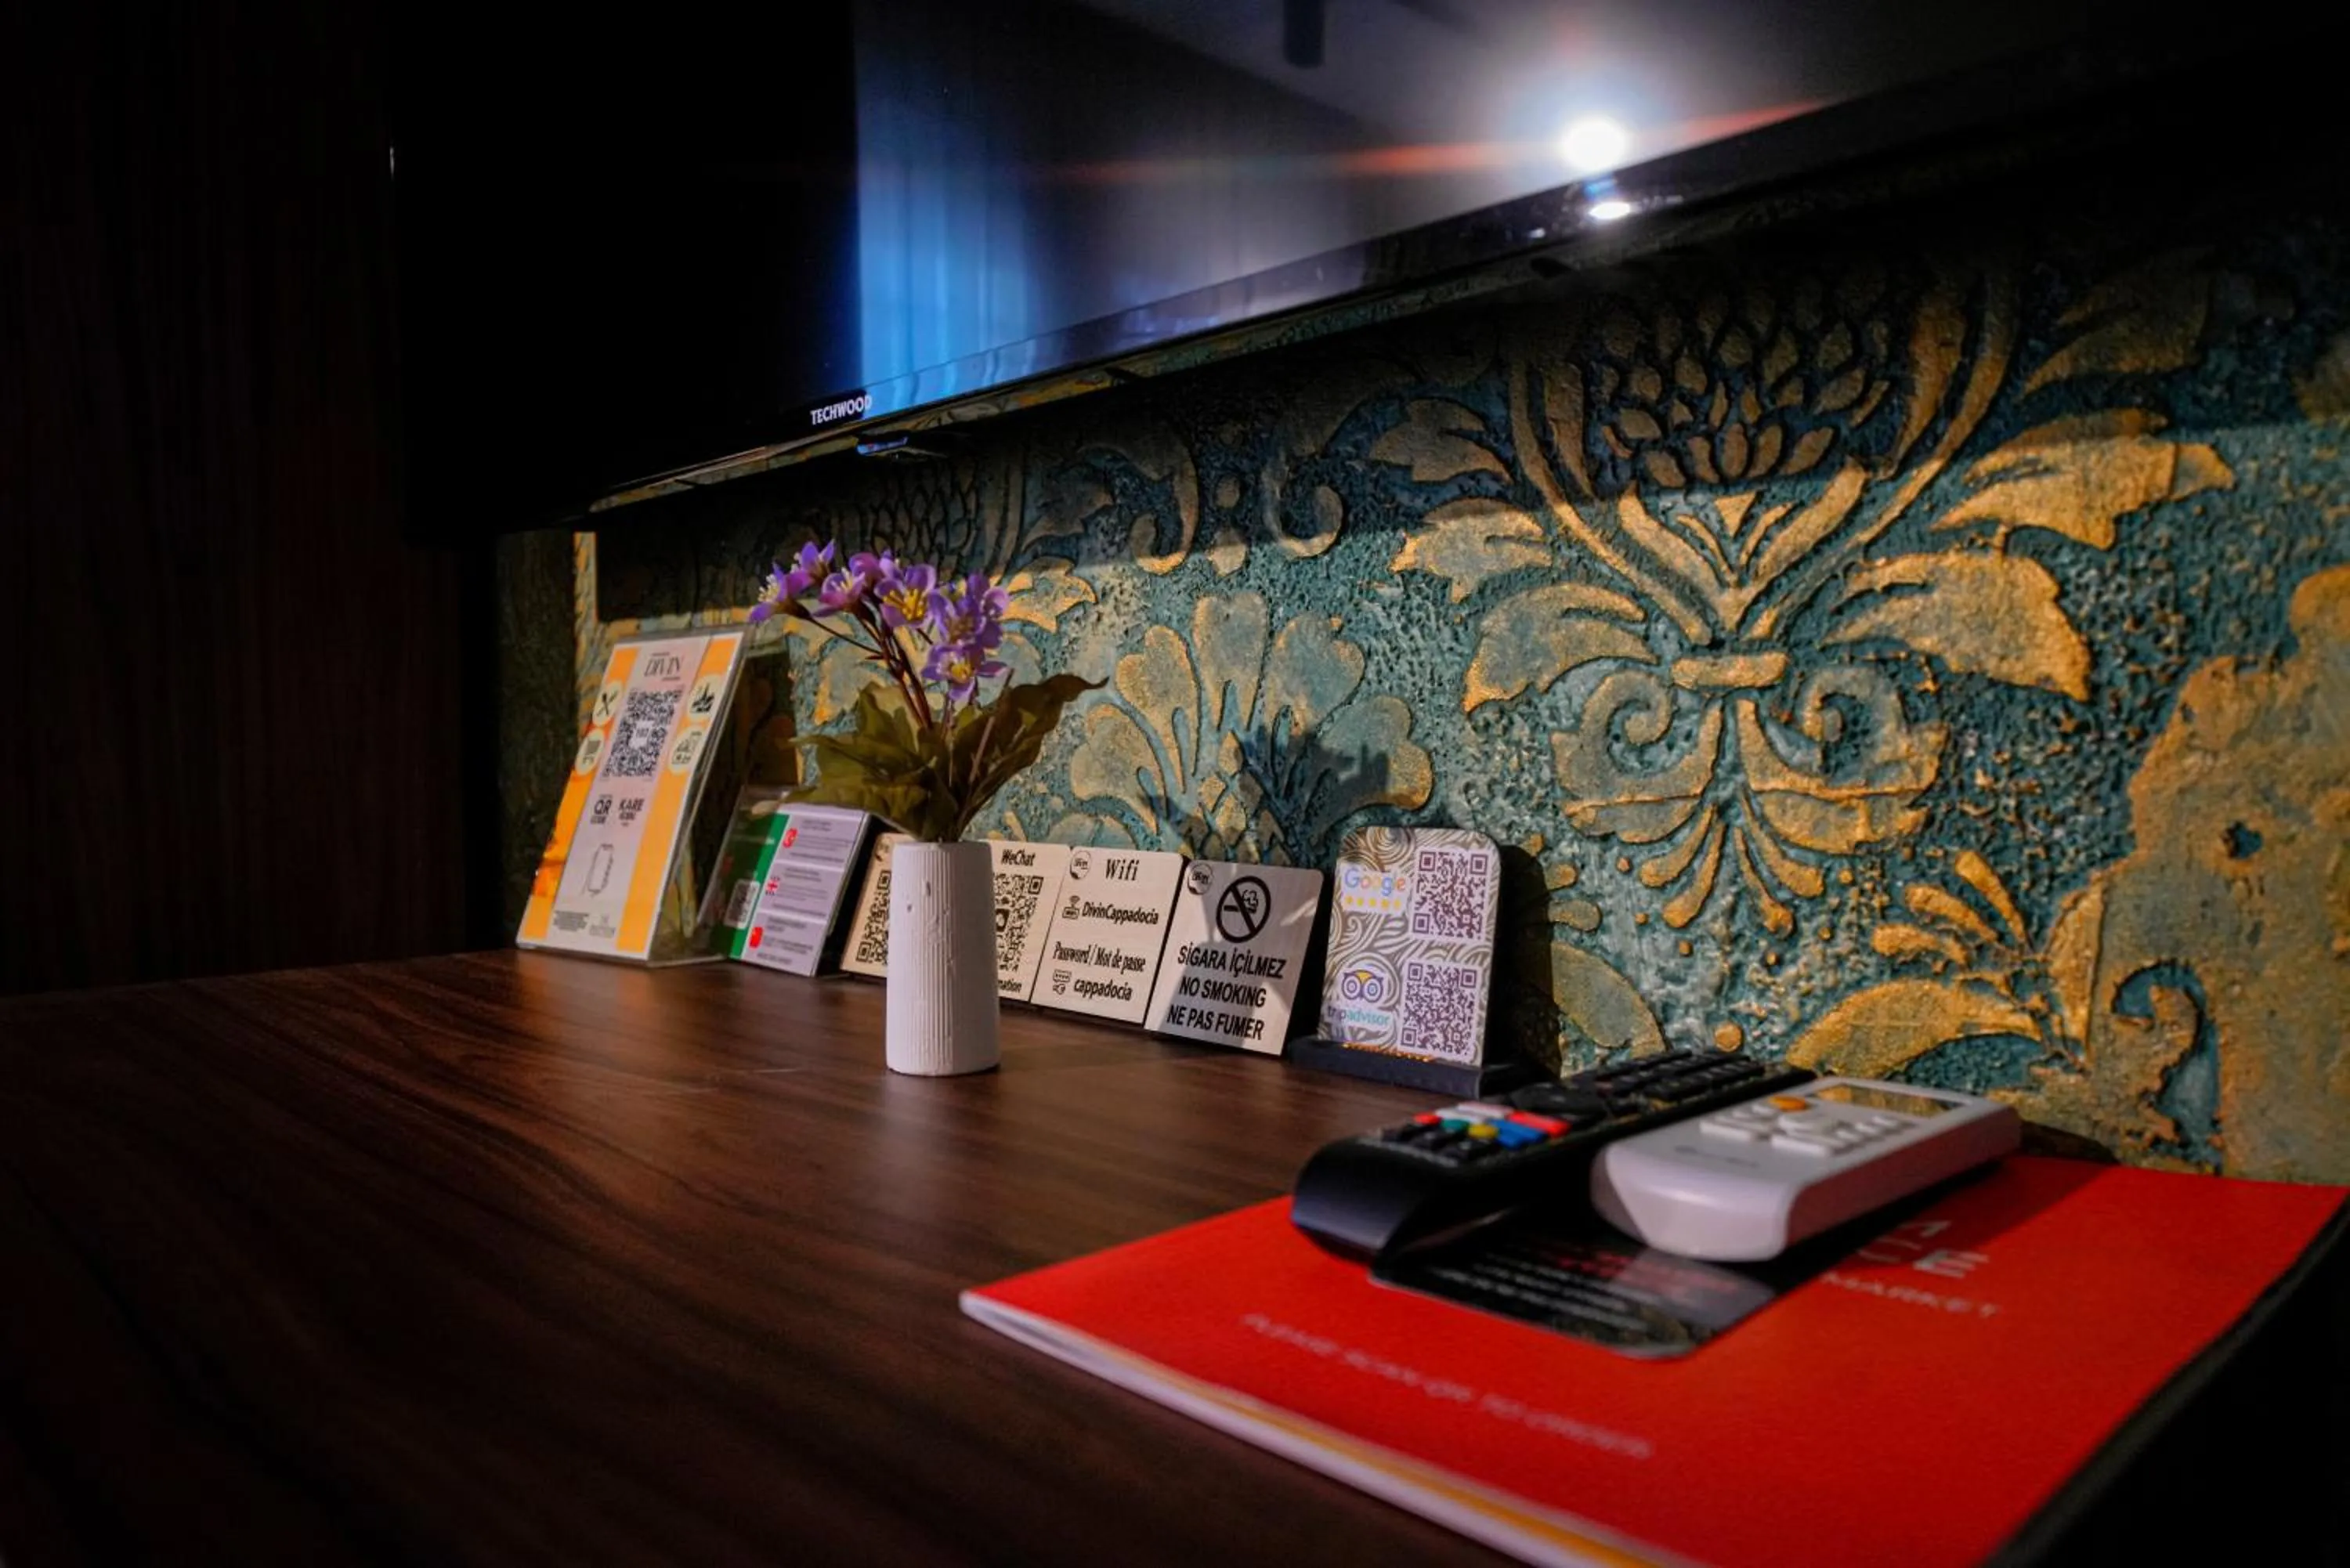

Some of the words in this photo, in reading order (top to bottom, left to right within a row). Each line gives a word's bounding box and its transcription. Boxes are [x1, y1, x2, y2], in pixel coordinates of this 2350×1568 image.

[810, 395, 873, 425] TECHWOOD
[1001, 848, 1036, 866] WeChat
[1105, 858, 1140, 881] Wifi
[1344, 866, 1406, 897] Google
[1082, 901, 1159, 925] DivinCappadocia
[1111, 948, 1123, 968] de
[1120, 955, 1146, 974] passe
[1177, 941, 1227, 972] SİGARA
[1229, 947, 1287, 979] İÇİLMEZ
[1073, 978, 1133, 1001] cappadocia
[1179, 976, 1201, 996] NO
[1201, 980, 1267, 1008] SMOKING
[1166, 1004, 1187, 1025] NE
[1187, 1008, 1214, 1030] PAS
[1215, 1013, 1265, 1040] FUMER
